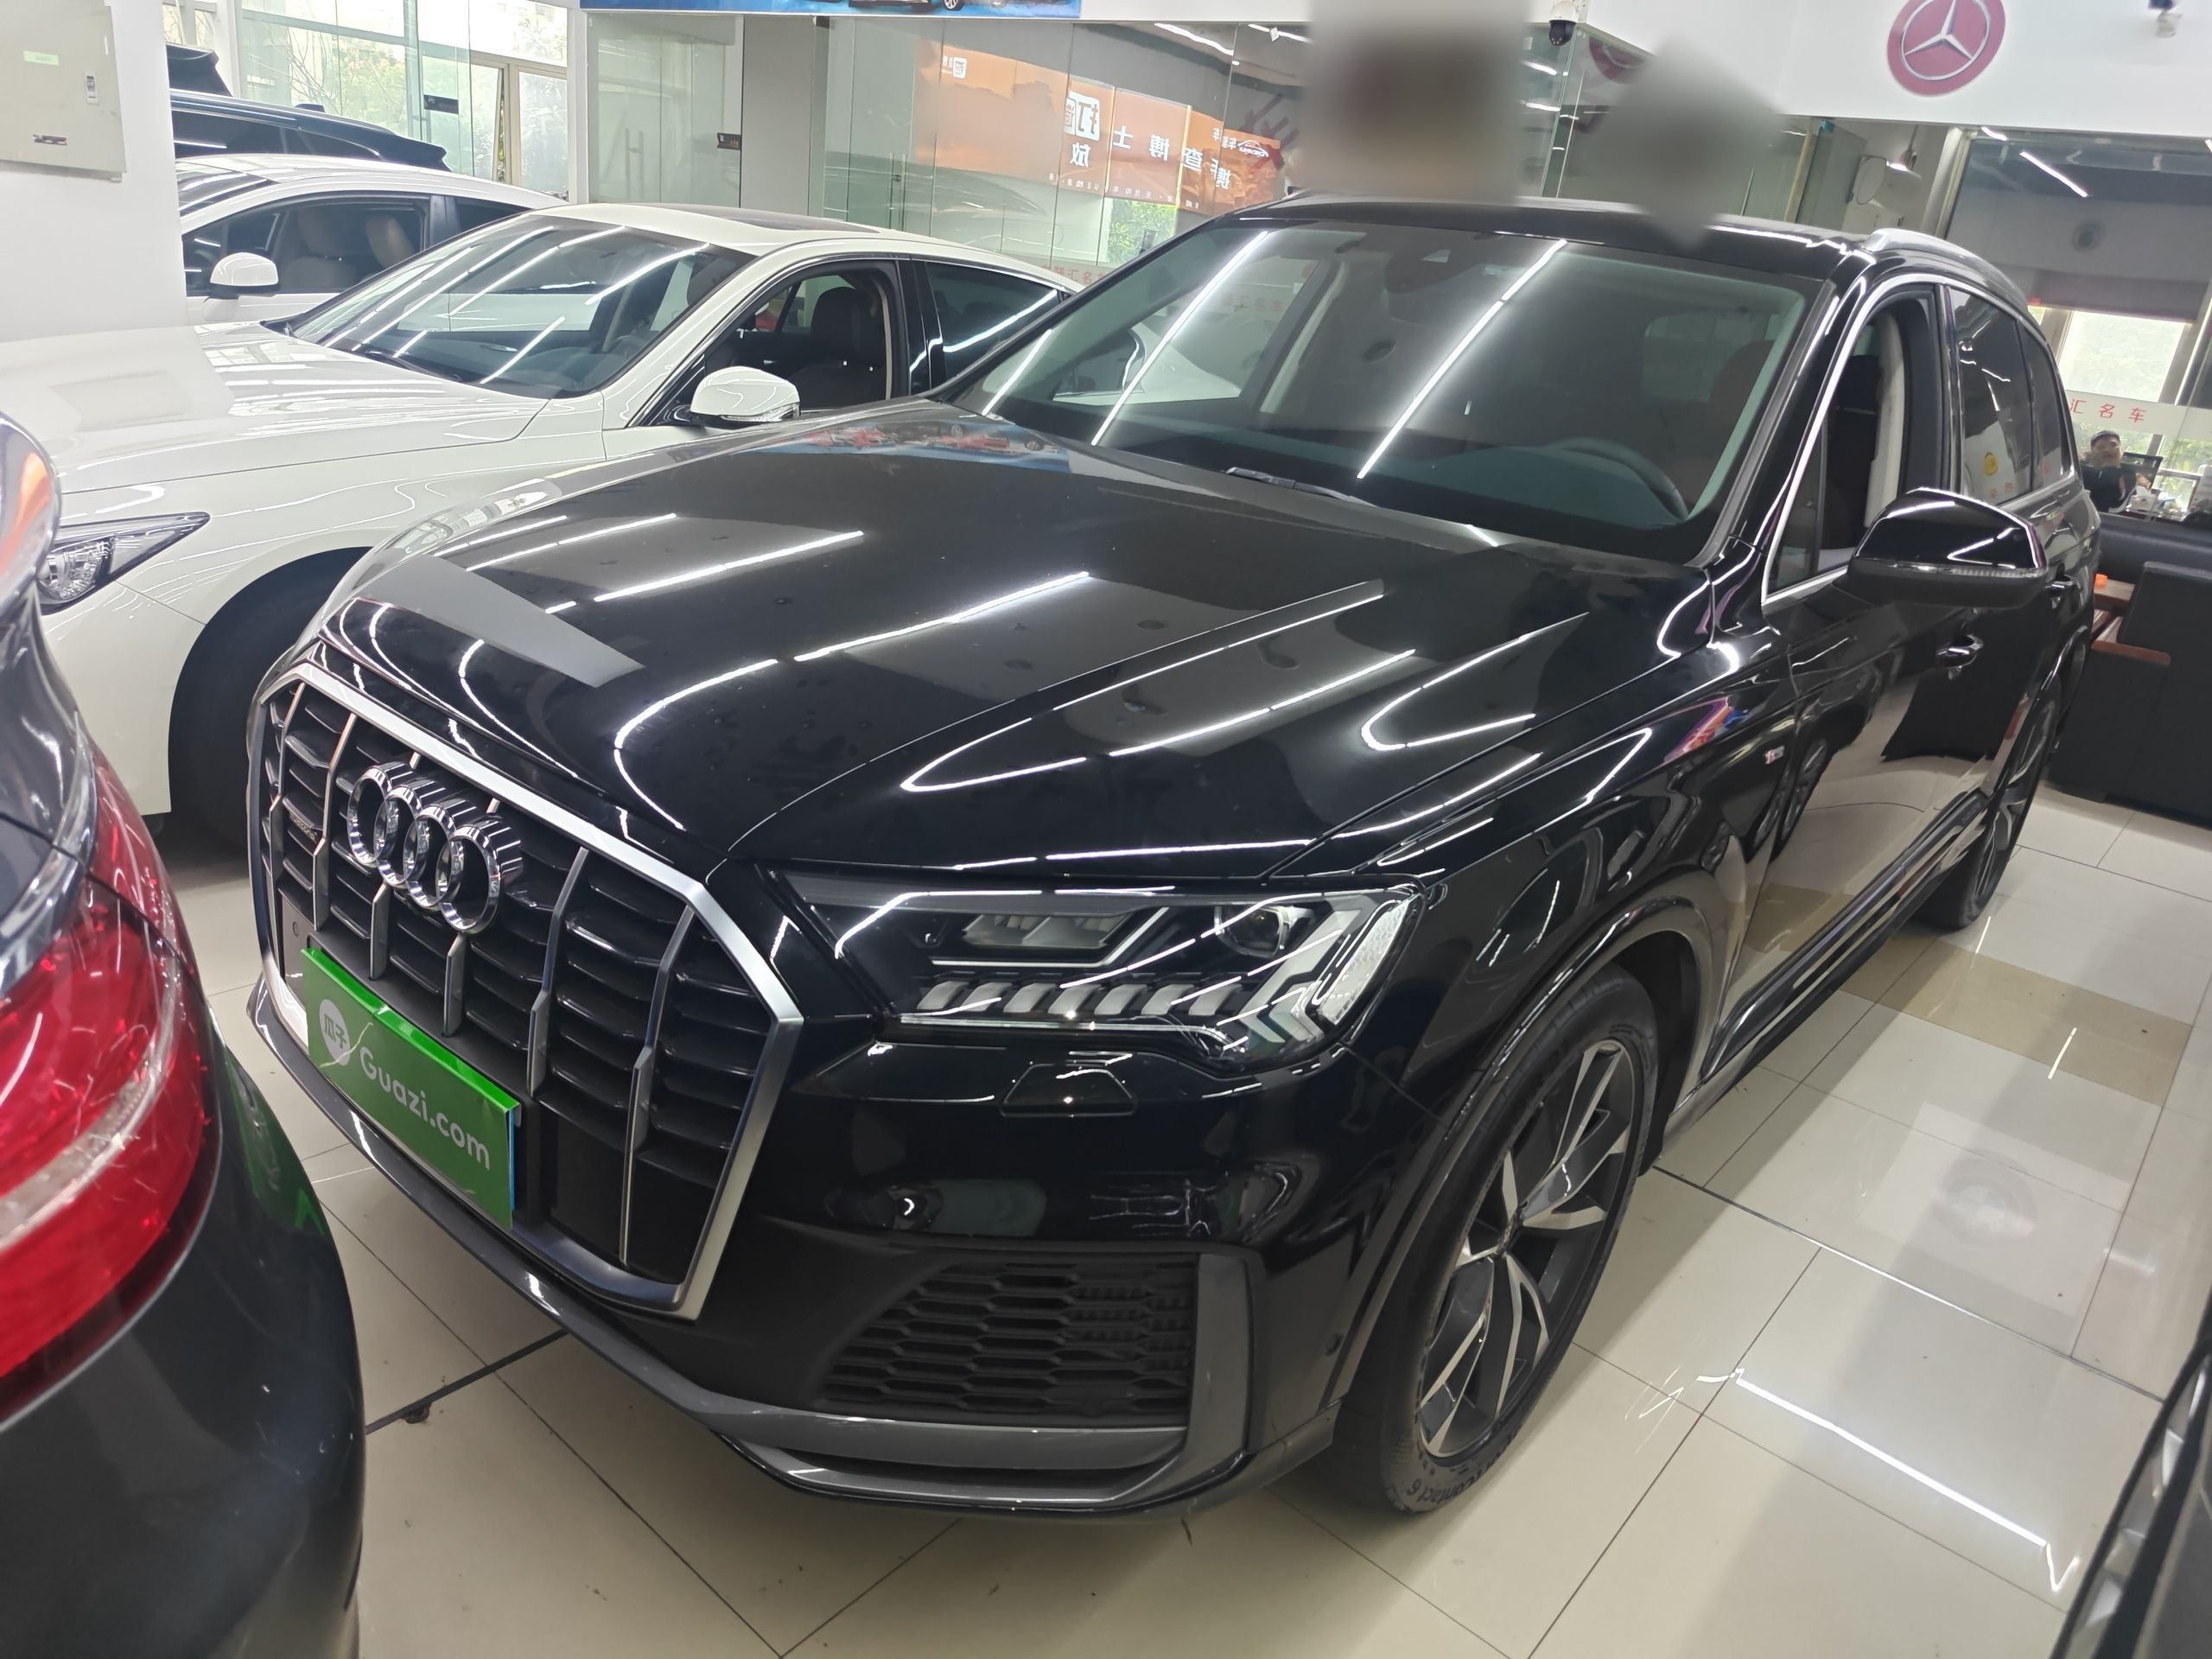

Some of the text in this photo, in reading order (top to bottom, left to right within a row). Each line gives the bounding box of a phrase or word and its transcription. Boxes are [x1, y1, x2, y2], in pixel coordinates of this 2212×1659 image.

[2069, 398, 2145, 423] 汇名车
[323, 1014, 346, 1050] 瓜子
[360, 1046, 491, 1171] Guazi.com
